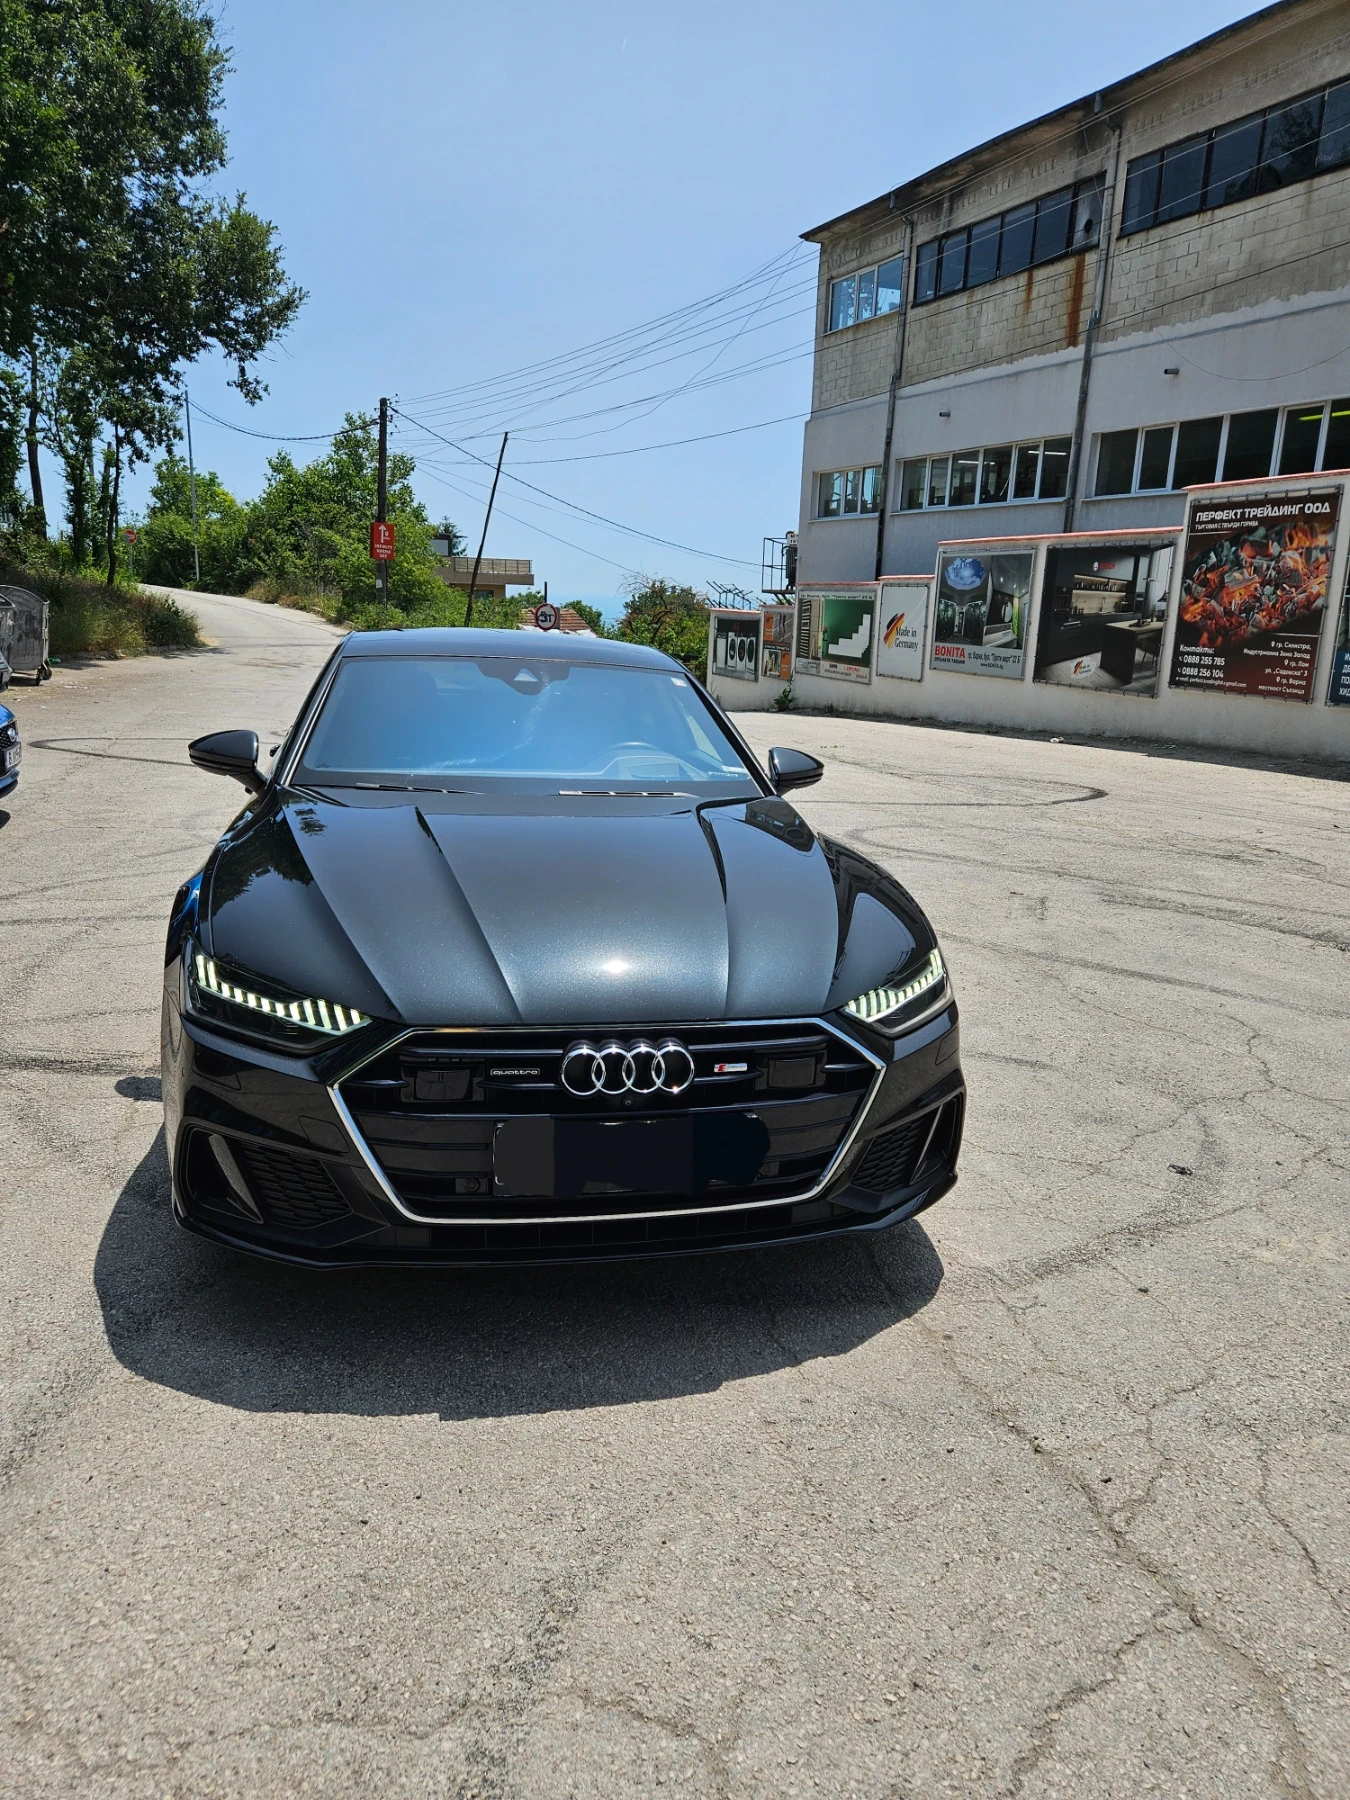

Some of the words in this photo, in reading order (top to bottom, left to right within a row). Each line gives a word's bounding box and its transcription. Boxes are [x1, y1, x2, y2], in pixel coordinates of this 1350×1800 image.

[1196, 508, 1244, 522] ПЕРФЕКТ
[1244, 503, 1303, 518] ТРЕЙДИНГ
[1304, 502, 1331, 514] ООД
[896, 626, 910, 637] Made
[911, 627, 916, 637] in
[895, 637, 918, 652] Germany
[1180, 644, 1215, 654] Контакти:
[1284, 642, 1311, 650] Силистра,
[934, 645, 966, 658] BONITA
[1243, 648, 1279, 656] Индустриална
[1293, 651, 1310, 659] Запад
[1013, 655, 1017, 663] 22
[1183, 655, 1200, 664] 0888
[1200, 656, 1213, 665] 255
[1213, 657, 1225, 666] 785
[1182, 667, 1198, 675] 0888
[1199, 668, 1211, 677] 256
[1212, 669, 1224, 678] 104
